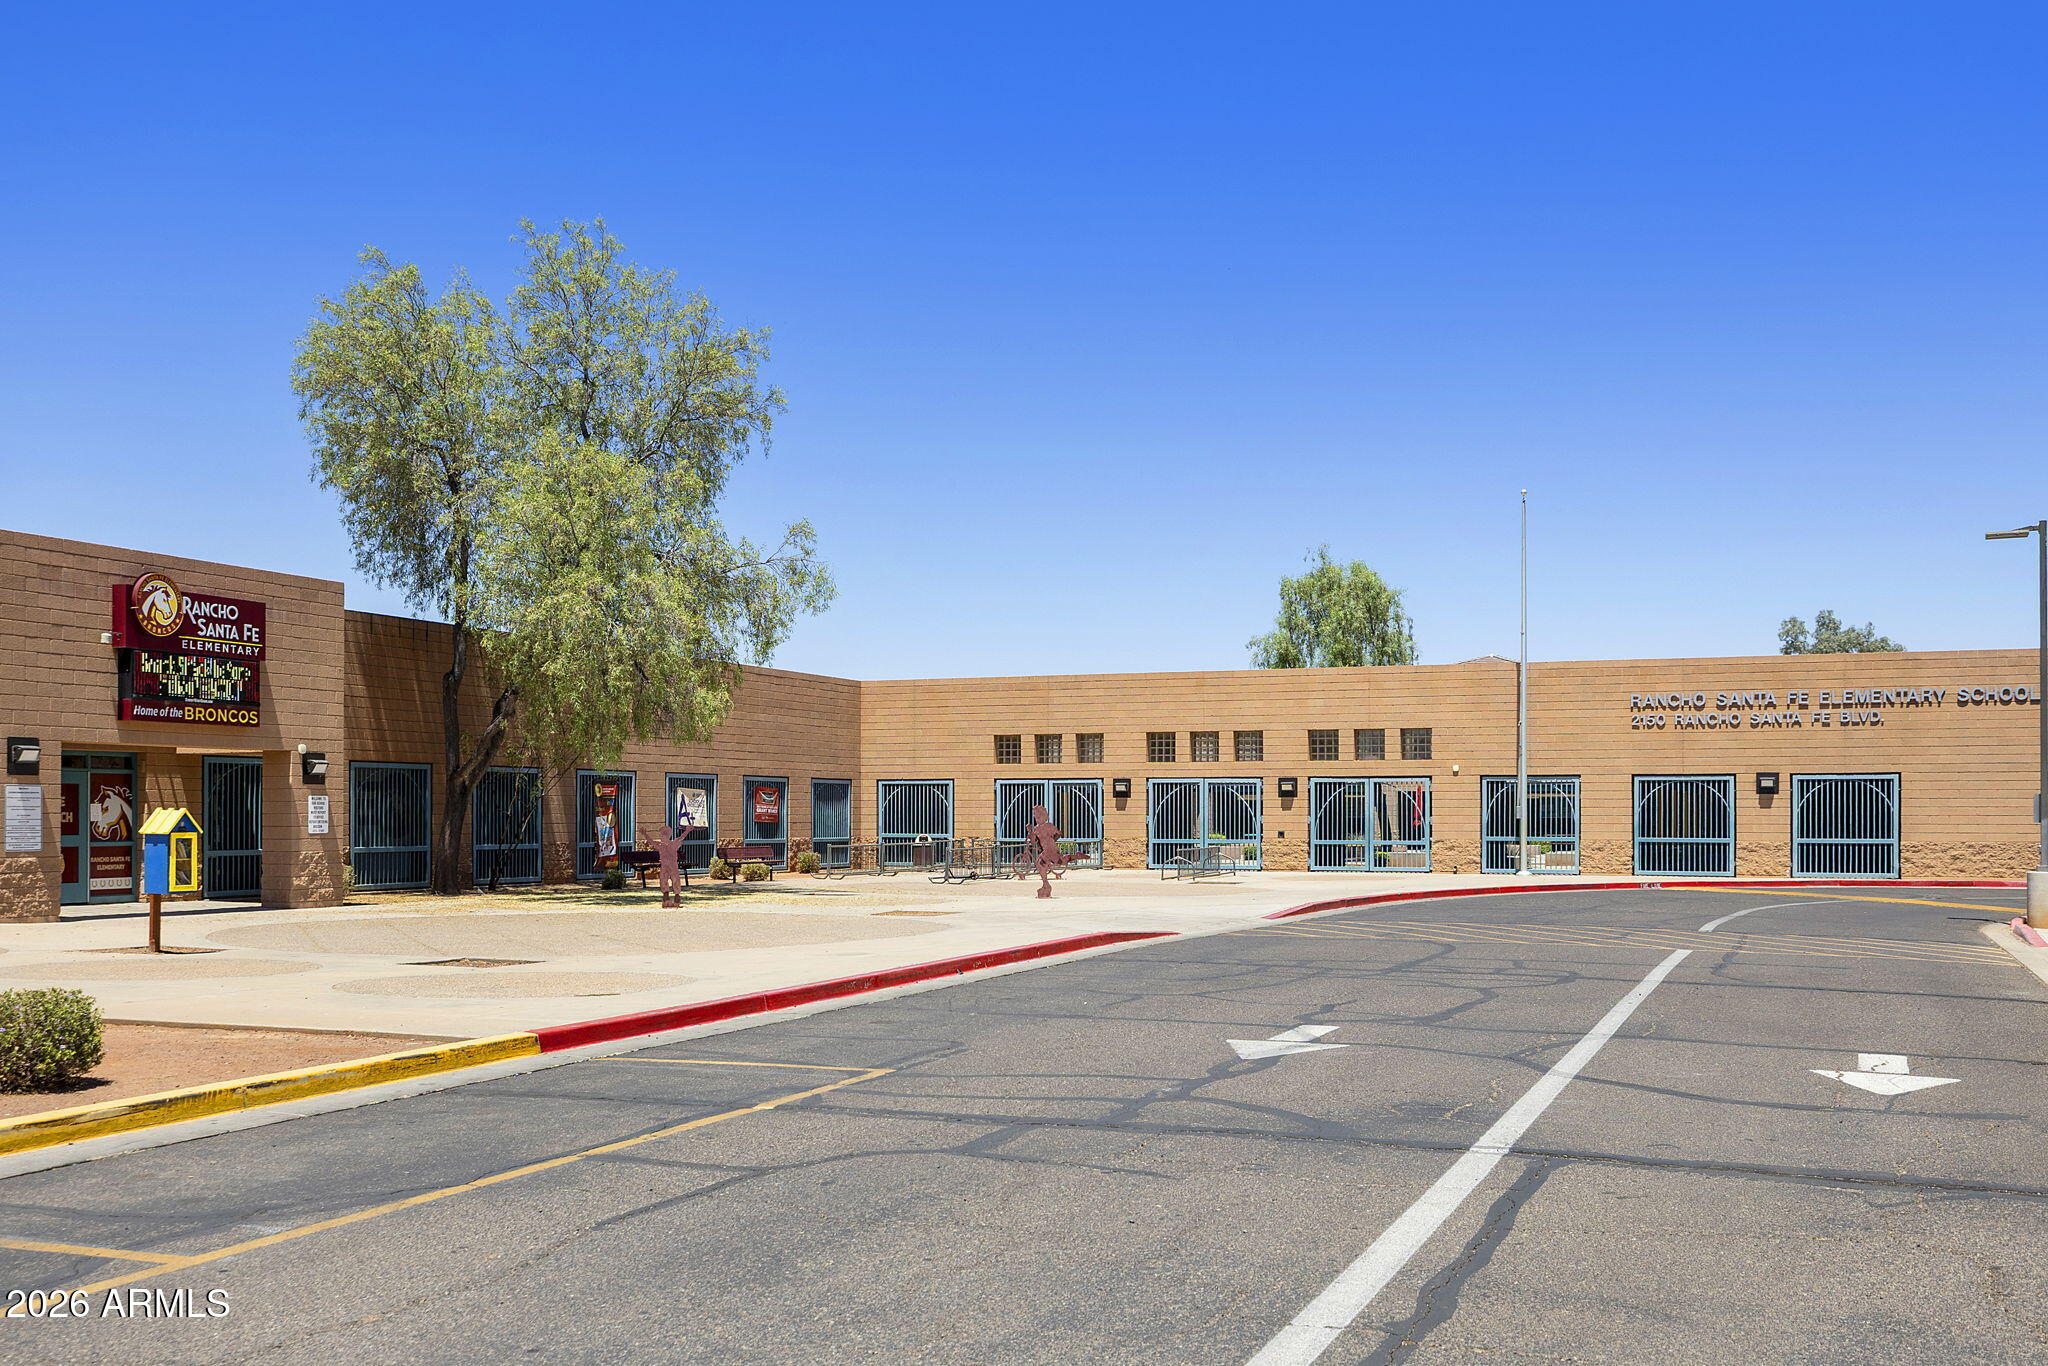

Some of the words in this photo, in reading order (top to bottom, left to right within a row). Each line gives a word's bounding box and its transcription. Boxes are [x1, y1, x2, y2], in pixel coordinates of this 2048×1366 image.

[182, 596, 239, 625] RANCHO
[197, 618, 239, 640] SANTA
[243, 623, 260, 643] FE
[181, 639, 260, 656] ELEMENTARY
[1630, 692, 1706, 708] RANCHO
[1716, 691, 1777, 707] SANTA
[1787, 690, 1809, 705] FE
[1819, 687, 1946, 704] ELEMENTARY
[1957, 686, 2041, 702] SCHOOL
[133, 705, 158, 717] Home
[159, 706, 169, 717] of
[170, 707, 183, 718] the
[184, 706, 258, 724] BRONCOS
[1631, 713, 1666, 726] 2150
[1674, 713, 1741, 726] RANCHO
[1750, 712, 1802, 724] SANTA
[1811, 710, 1831, 723] FE
[1840, 710, 1884, 723] BLVD.
